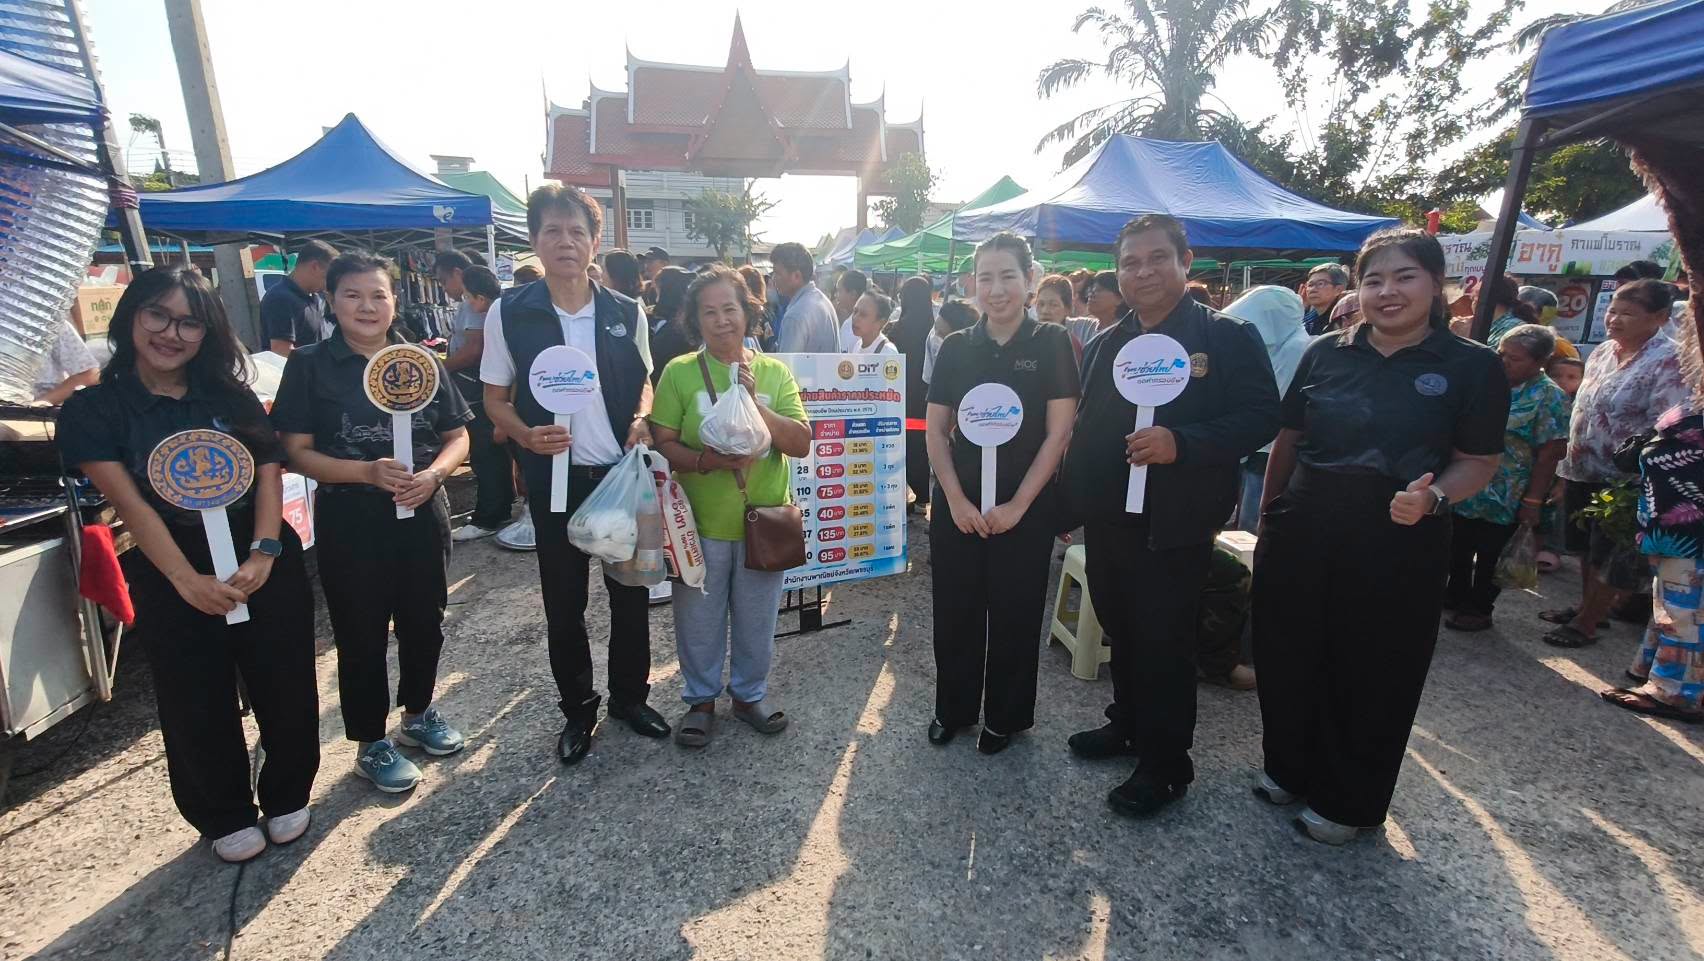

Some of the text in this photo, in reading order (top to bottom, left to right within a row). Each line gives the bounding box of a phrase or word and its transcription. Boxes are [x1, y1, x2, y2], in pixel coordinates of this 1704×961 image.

[799, 387, 902, 403] น่ายสินค้าราคาประหยัด
[819, 445, 833, 455] 35
[797, 466, 809, 475] 28
[820, 466, 832, 476] 19
[796, 486, 811, 496] 110
[820, 487, 833, 497] 75
[287, 508, 304, 525] 75
[820, 509, 833, 519] 40
[819, 530, 836, 540] 135
[820, 551, 834, 561] 95
